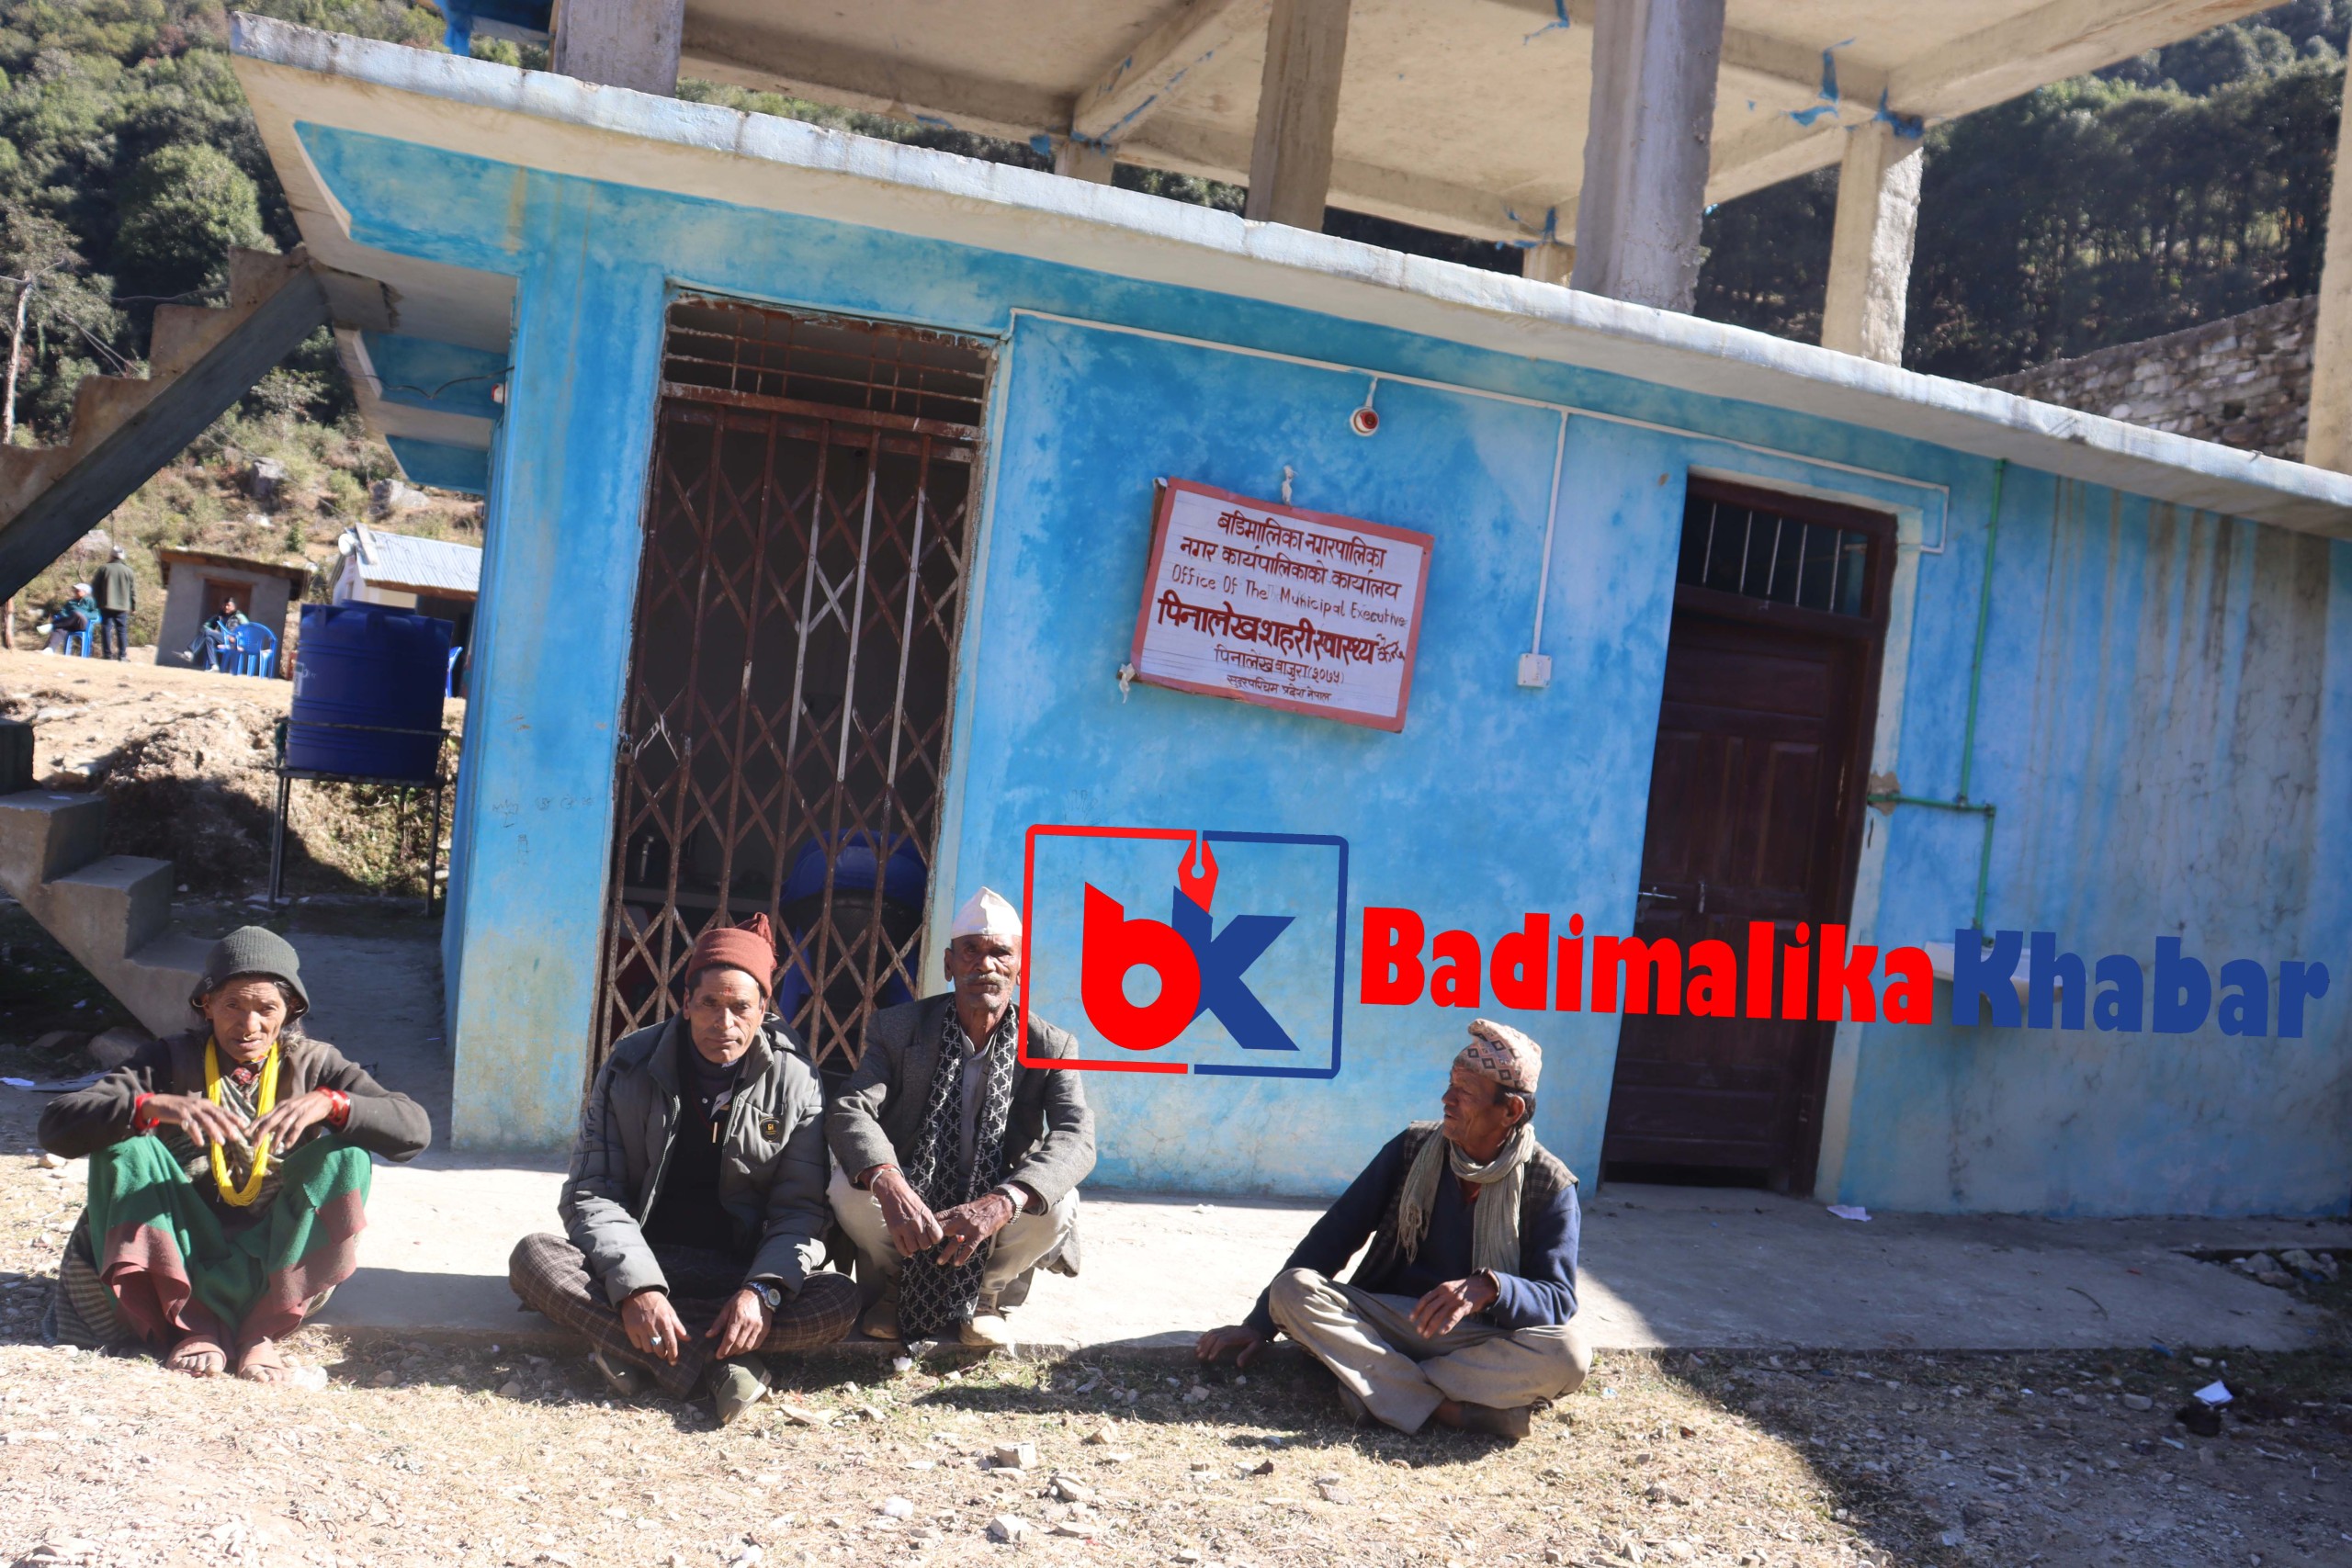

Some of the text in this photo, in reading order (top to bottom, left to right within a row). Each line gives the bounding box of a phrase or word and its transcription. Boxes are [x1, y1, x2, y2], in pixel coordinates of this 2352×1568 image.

[1181, 536, 1402, 600] नगर कार्यपालिकाको कार्यालय
[1306, 536, 1387, 570] नगरपालिका
[1172, 564, 1407, 627] Office Of The Municipal Executive
[1307, 686, 1332, 702] नेपाल
